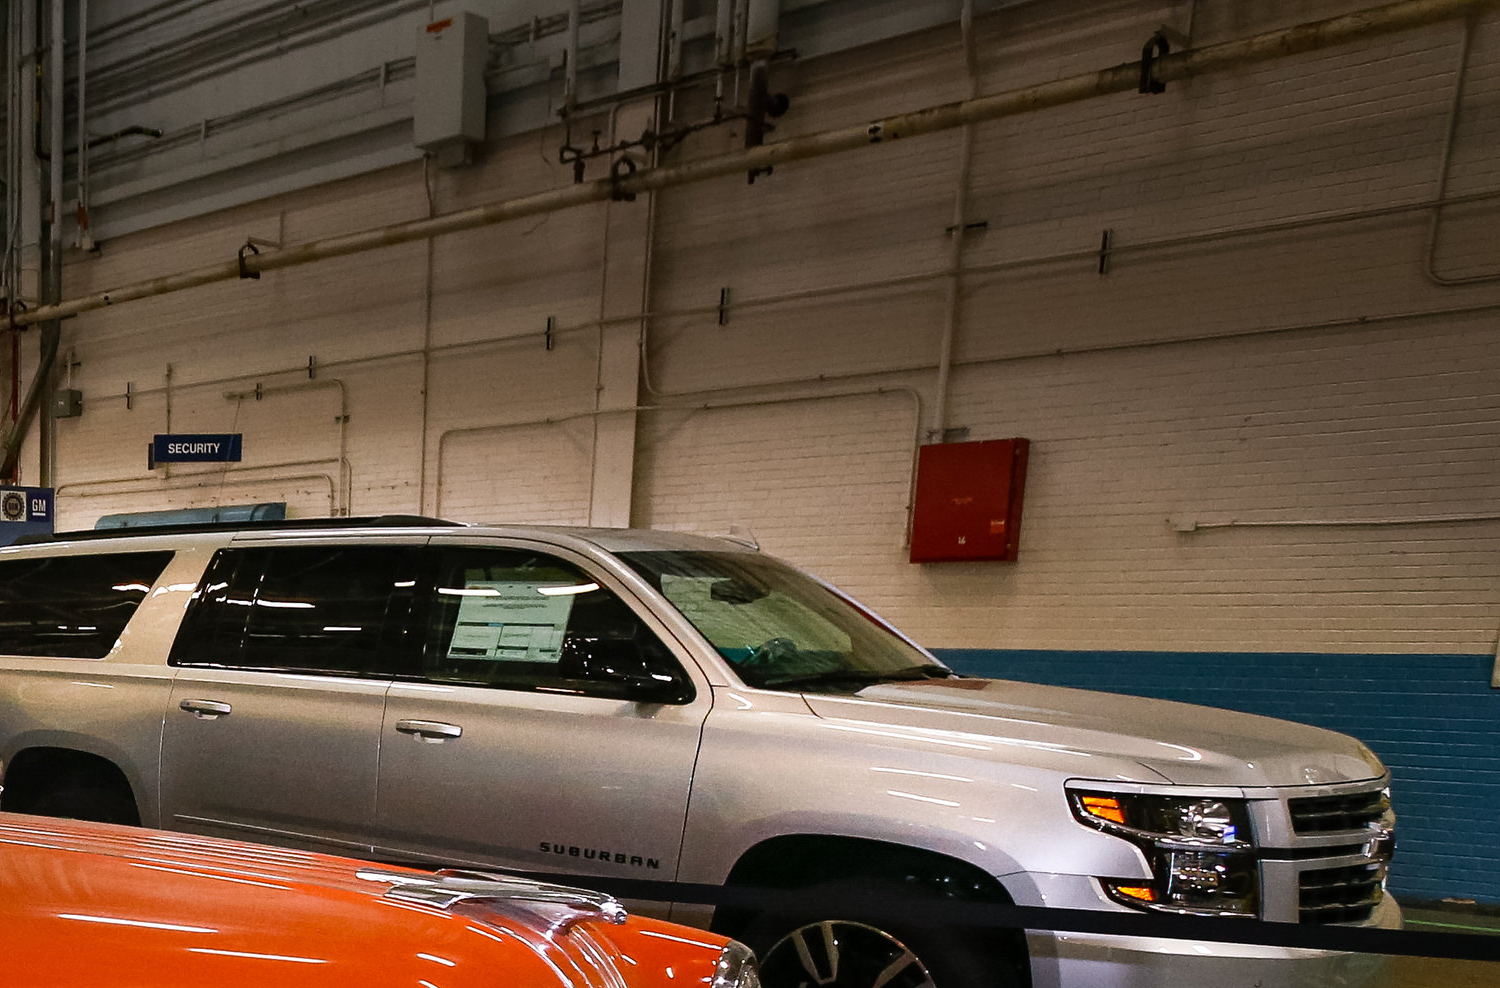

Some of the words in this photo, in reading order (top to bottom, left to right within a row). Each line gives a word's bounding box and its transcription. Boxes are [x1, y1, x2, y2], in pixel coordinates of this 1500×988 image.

[168, 443, 221, 454] SECURITY
[32, 499, 46, 512] GM
[539, 841, 660, 869] SUBURBAN
